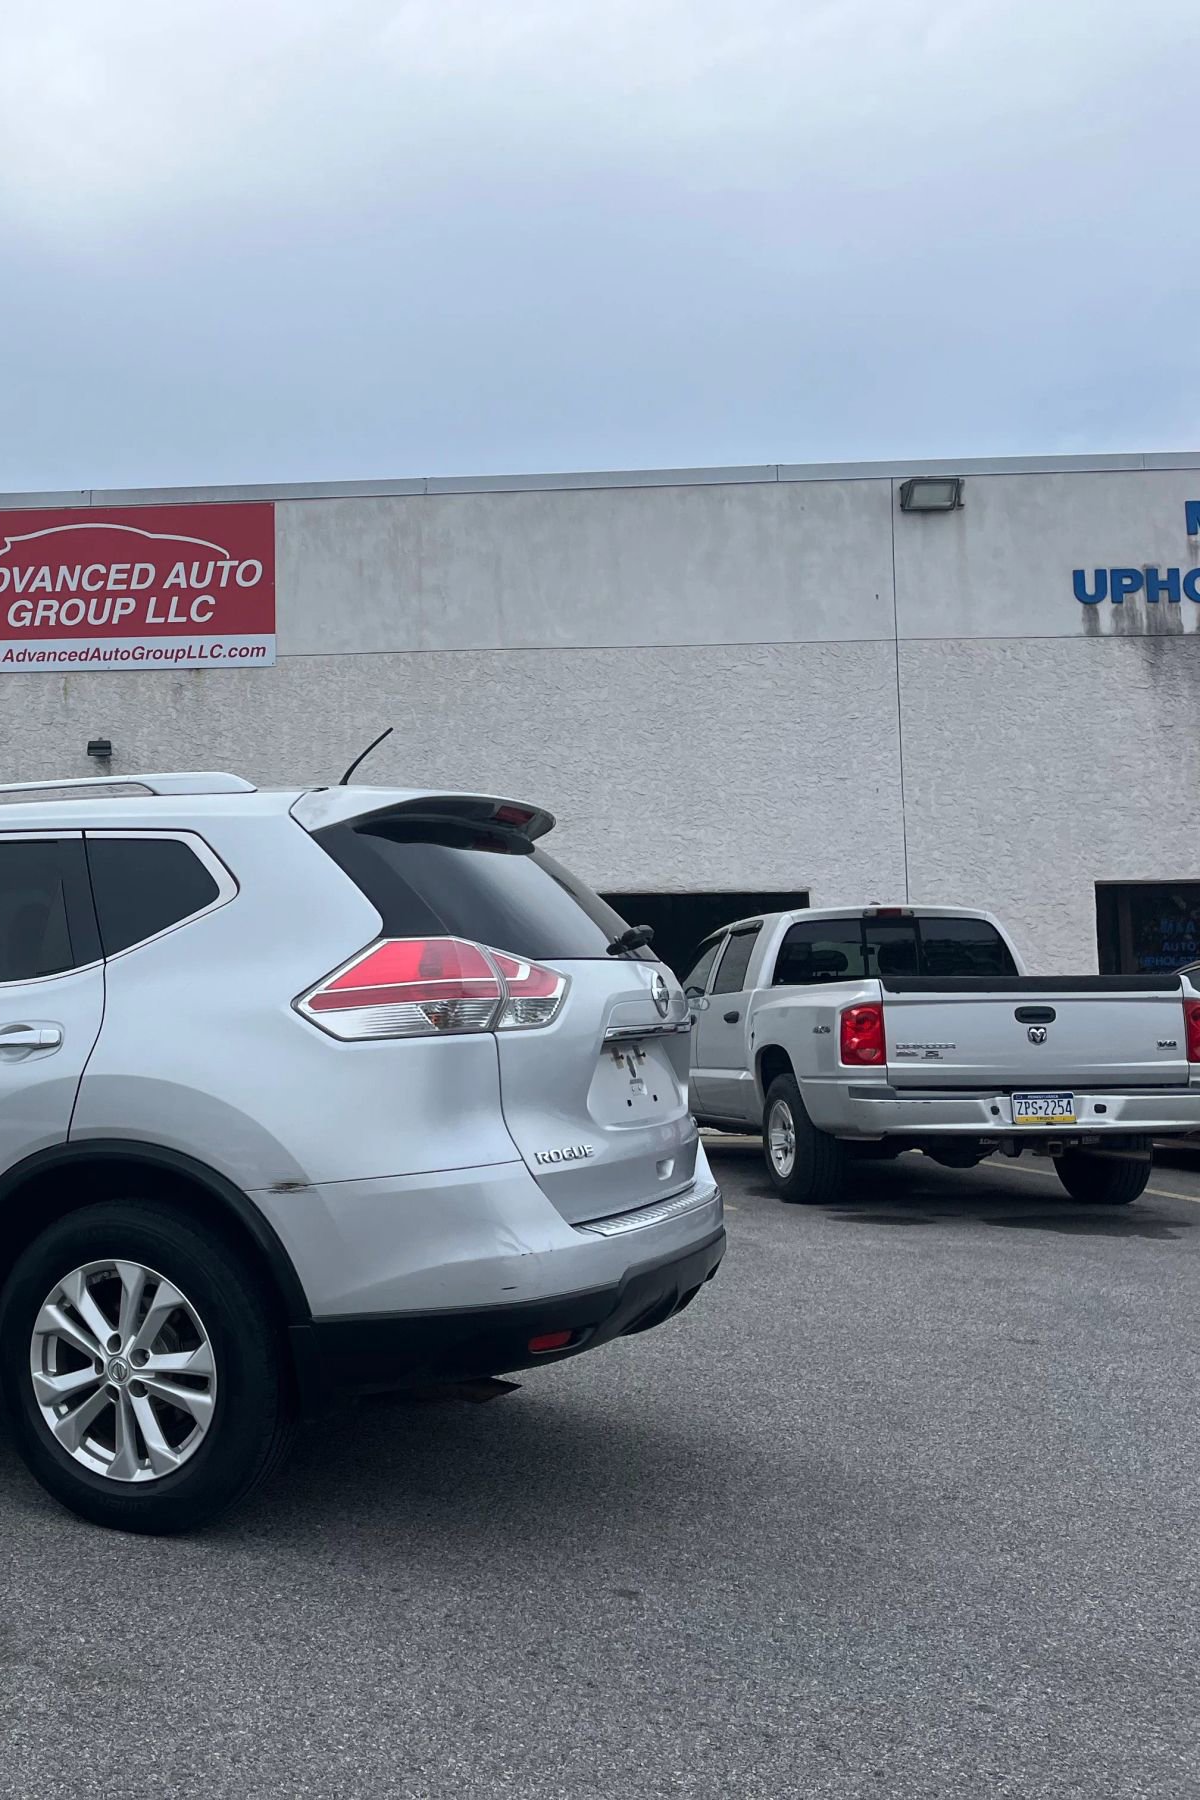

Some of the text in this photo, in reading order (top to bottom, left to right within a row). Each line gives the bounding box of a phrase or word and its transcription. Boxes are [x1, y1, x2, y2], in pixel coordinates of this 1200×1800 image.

[163, 559, 263, 588] AUTO
[7, 595, 216, 627] GROUP LLC
[534, 1144, 595, 1165] ROGUE
